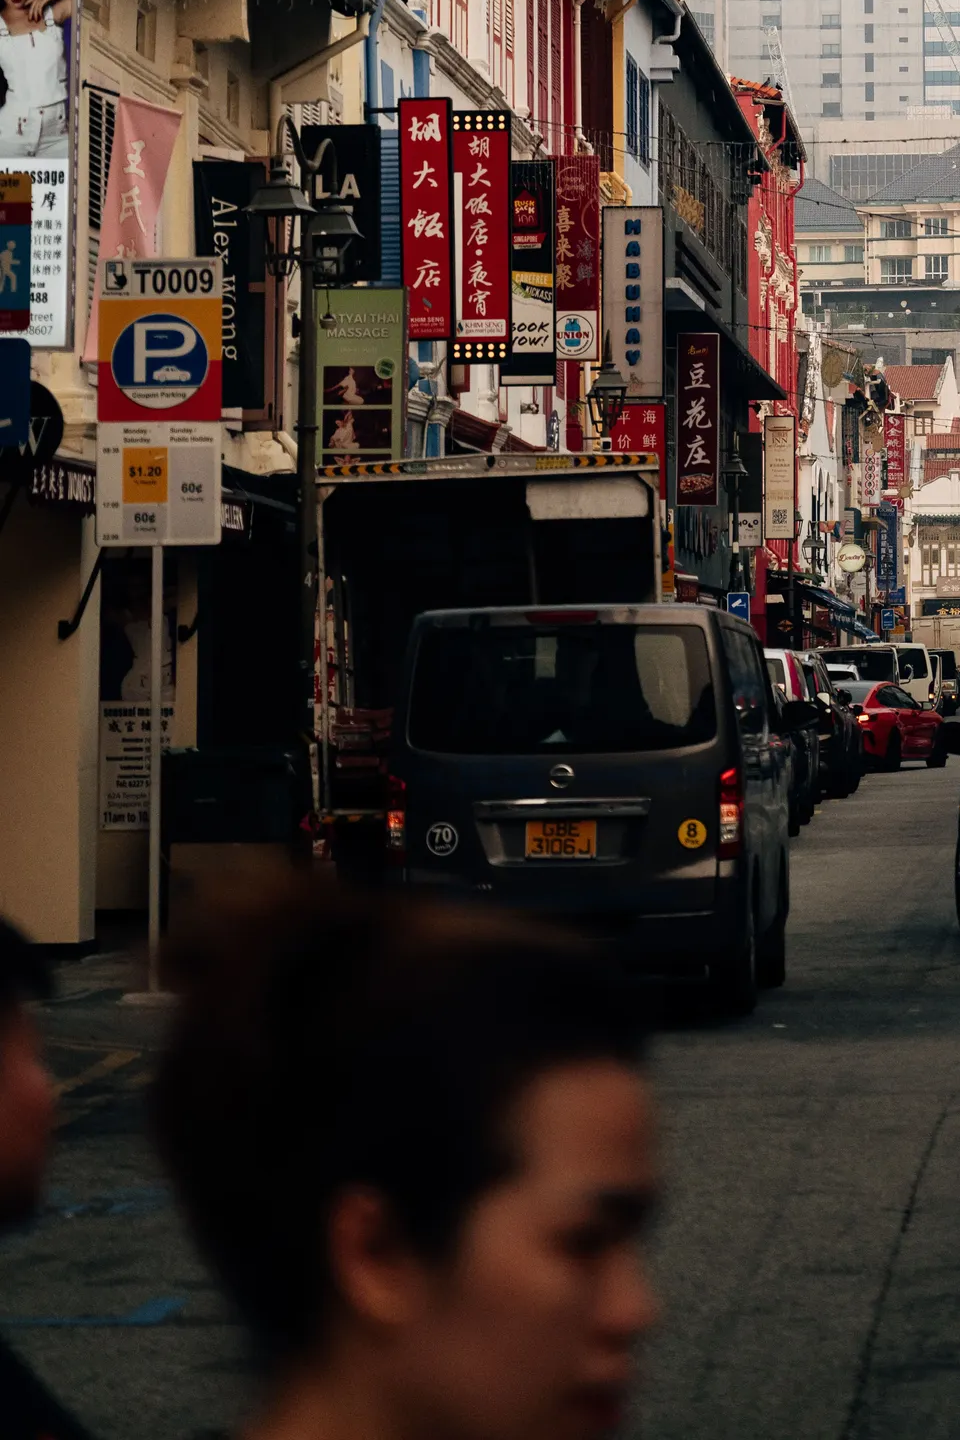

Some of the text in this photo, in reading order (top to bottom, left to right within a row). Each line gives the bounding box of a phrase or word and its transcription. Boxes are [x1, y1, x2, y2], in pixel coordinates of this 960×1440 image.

[211, 196, 239, 266] Alex
[556, 205, 576, 291] 喜来聚
[135, 268, 213, 294] T0009
[516, 273, 548, 286] CAREFREE
[525, 284, 552, 301] KICKASS
[30, 312, 54, 323] treet
[327, 327, 389, 338] MASSAGE
[557, 332, 591, 340] UNION
[161, 391, 187, 400] Parking
[683, 362, 712, 468] 豆花庄
[642, 409, 658, 449] 海鲜
[129, 466, 162, 478] $1.20
[181, 483, 203, 494] 60¢
[134, 513, 156, 523] 60¢
[127, 812, 136, 823] to
[432, 827, 452, 843] 70
[687, 822, 697, 838] 8
